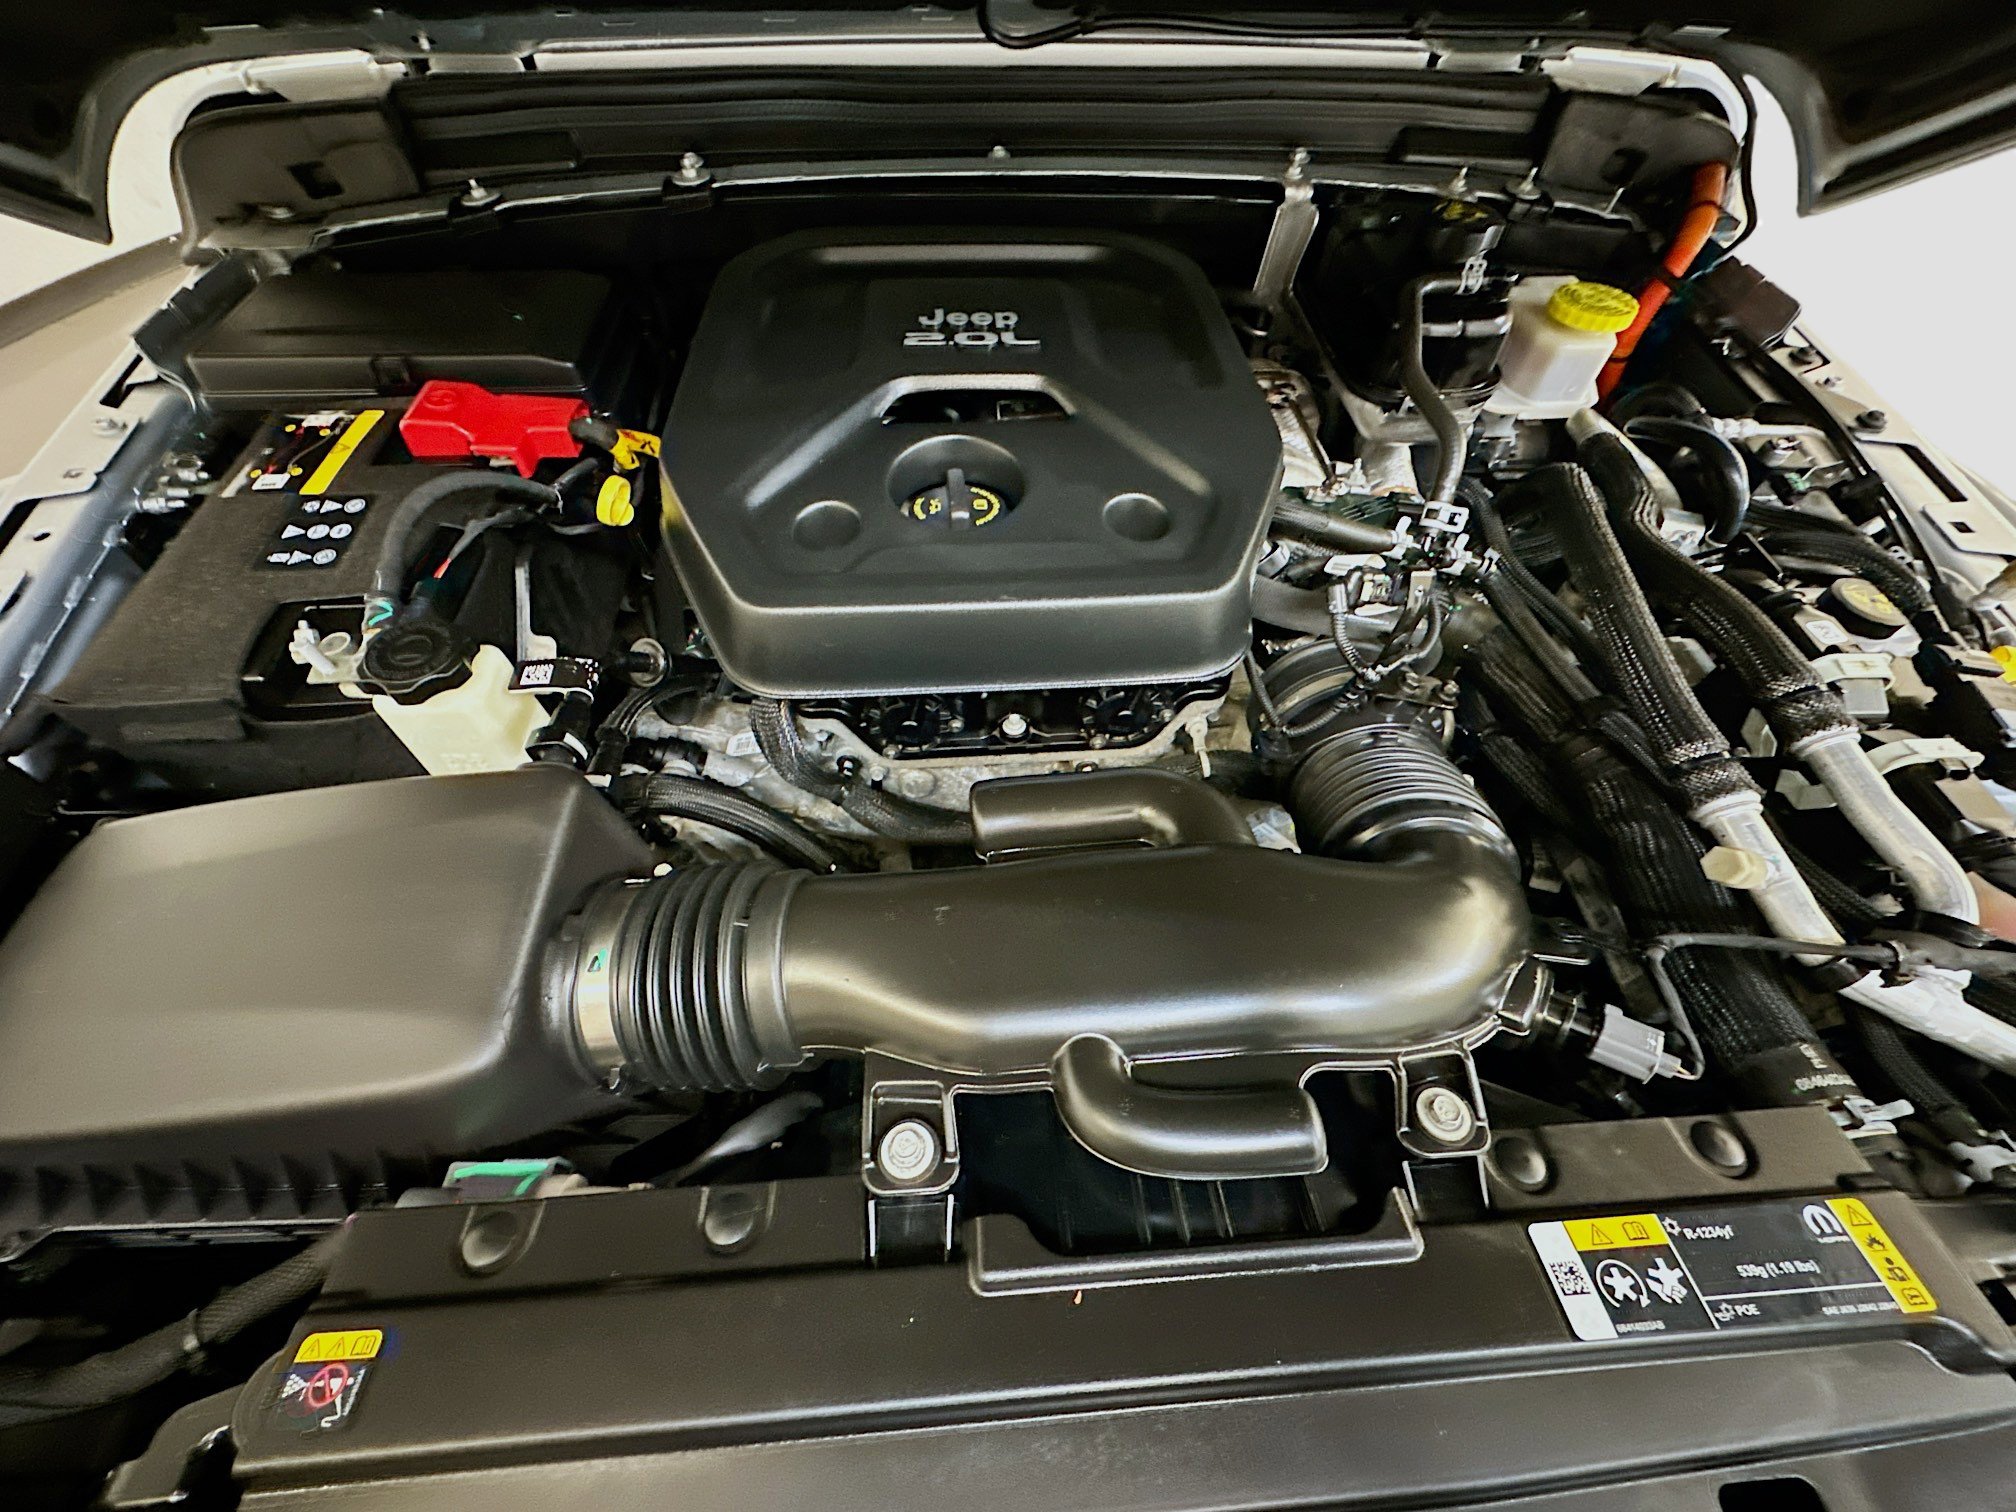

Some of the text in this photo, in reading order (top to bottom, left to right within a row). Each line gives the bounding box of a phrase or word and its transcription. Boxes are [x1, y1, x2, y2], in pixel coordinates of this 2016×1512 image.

[917, 308, 1019, 329] Jeep
[903, 331, 1041, 348] 2.0L
[1683, 1225, 1735, 1240] R-1234yf
[1734, 1303, 1762, 1317] POE
